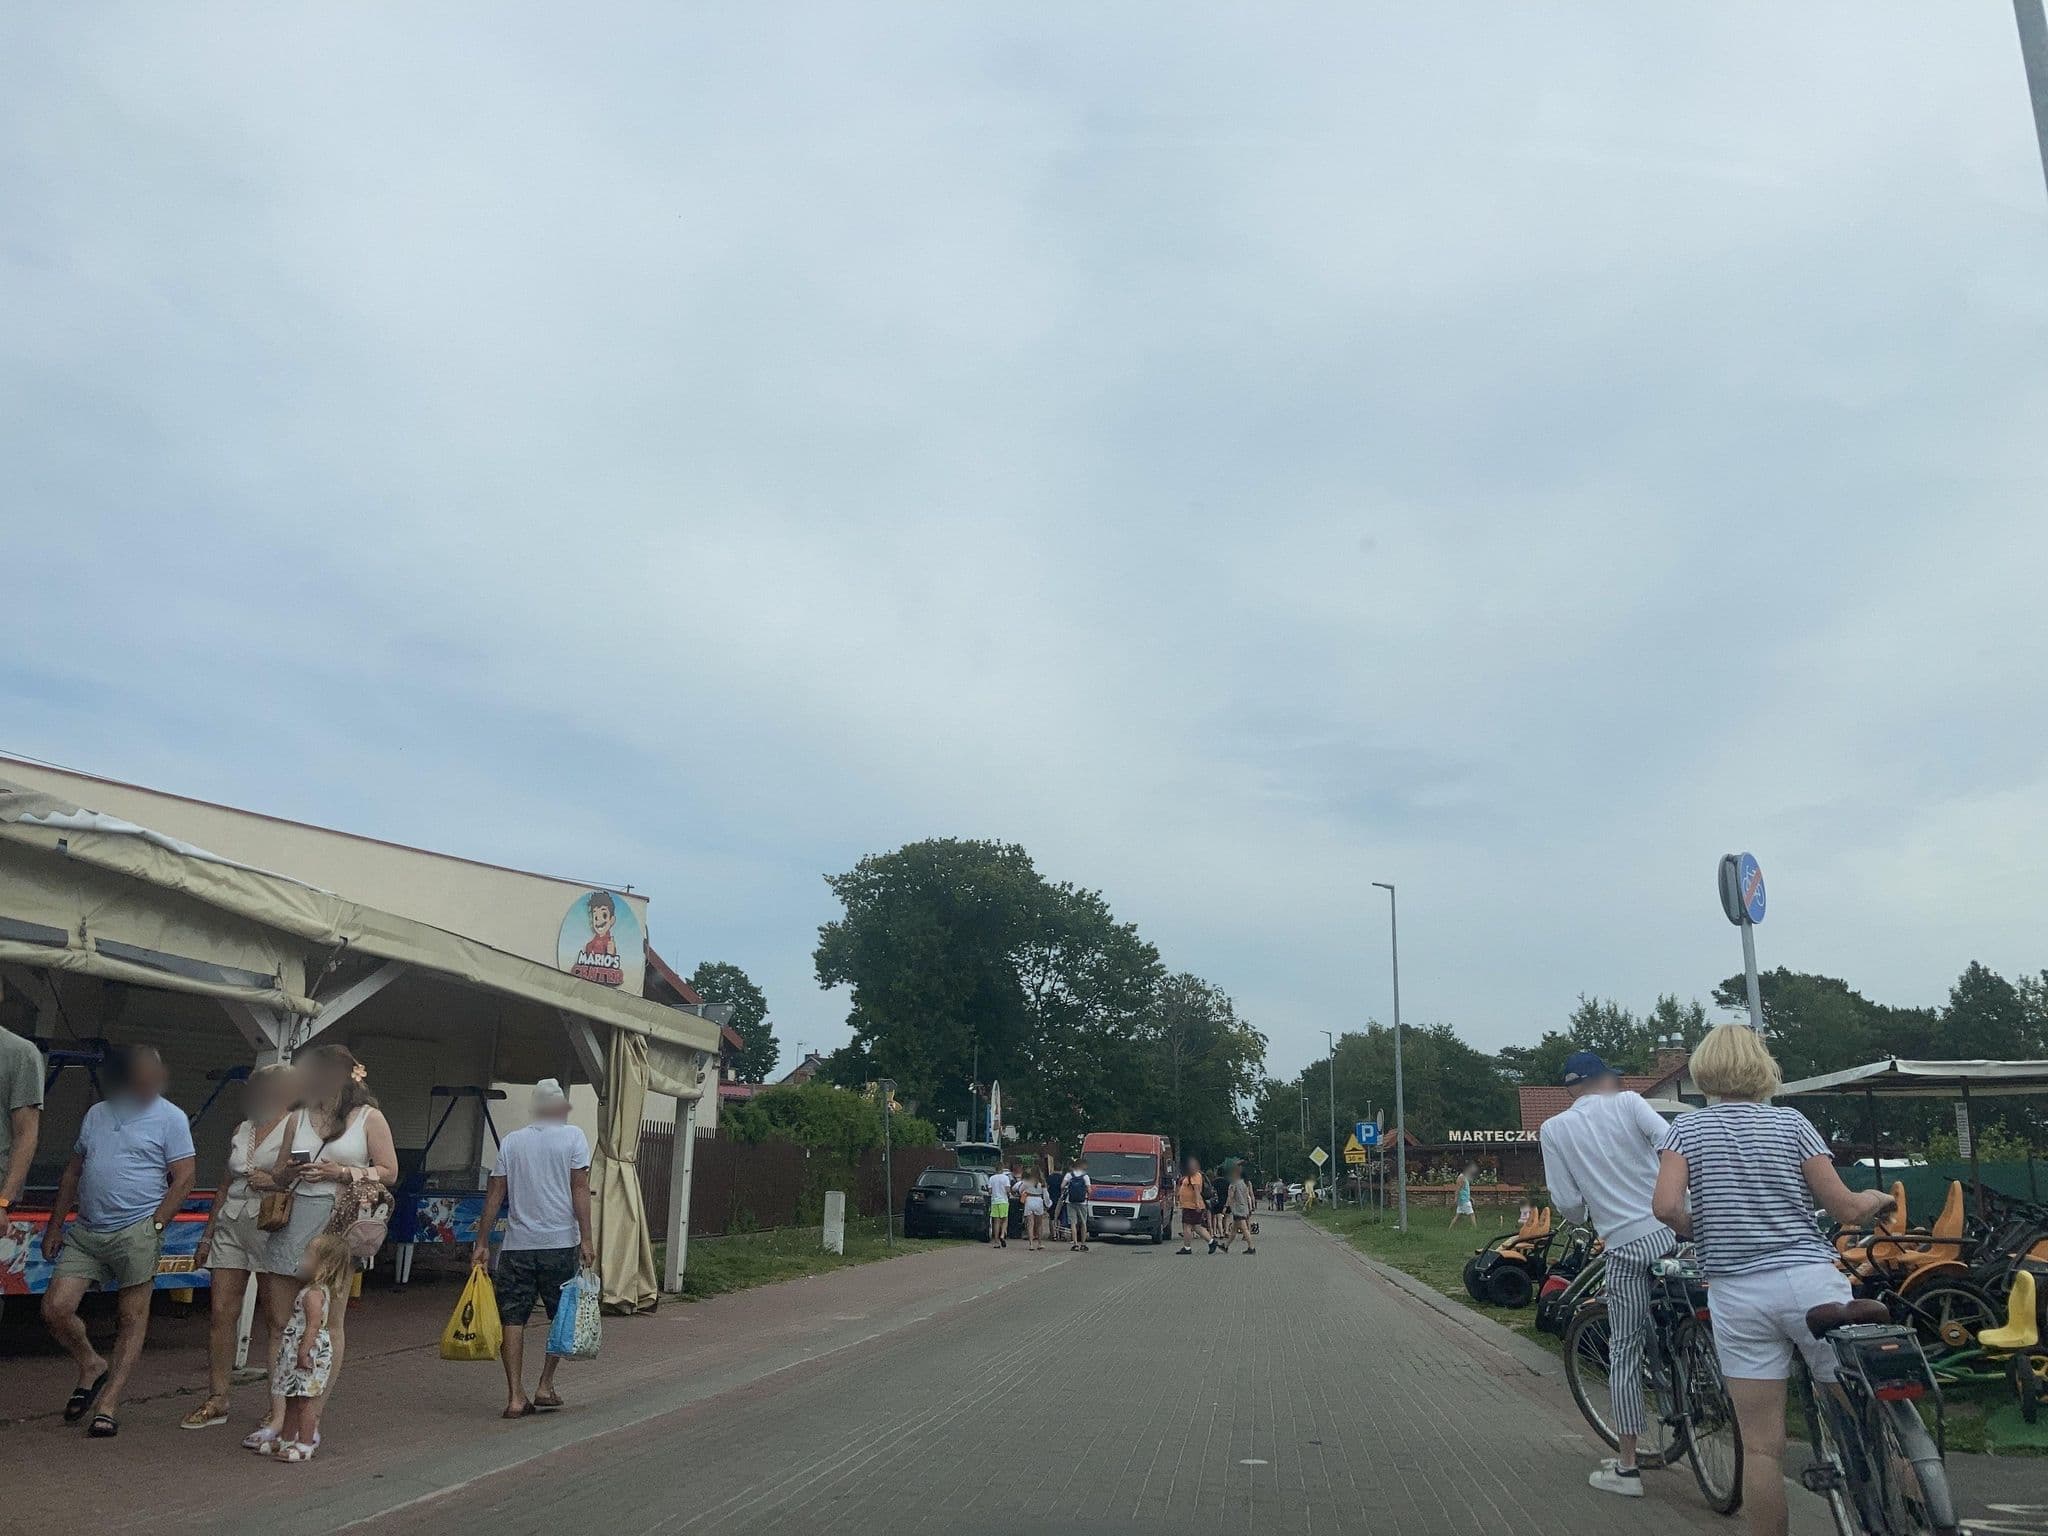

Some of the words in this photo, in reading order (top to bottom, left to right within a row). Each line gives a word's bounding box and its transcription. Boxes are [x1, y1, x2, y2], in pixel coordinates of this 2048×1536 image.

[578, 951, 620, 969] MARIO'S
[1361, 1124, 1374, 1142] P
[1448, 1130, 1538, 1142] MARTECZK
